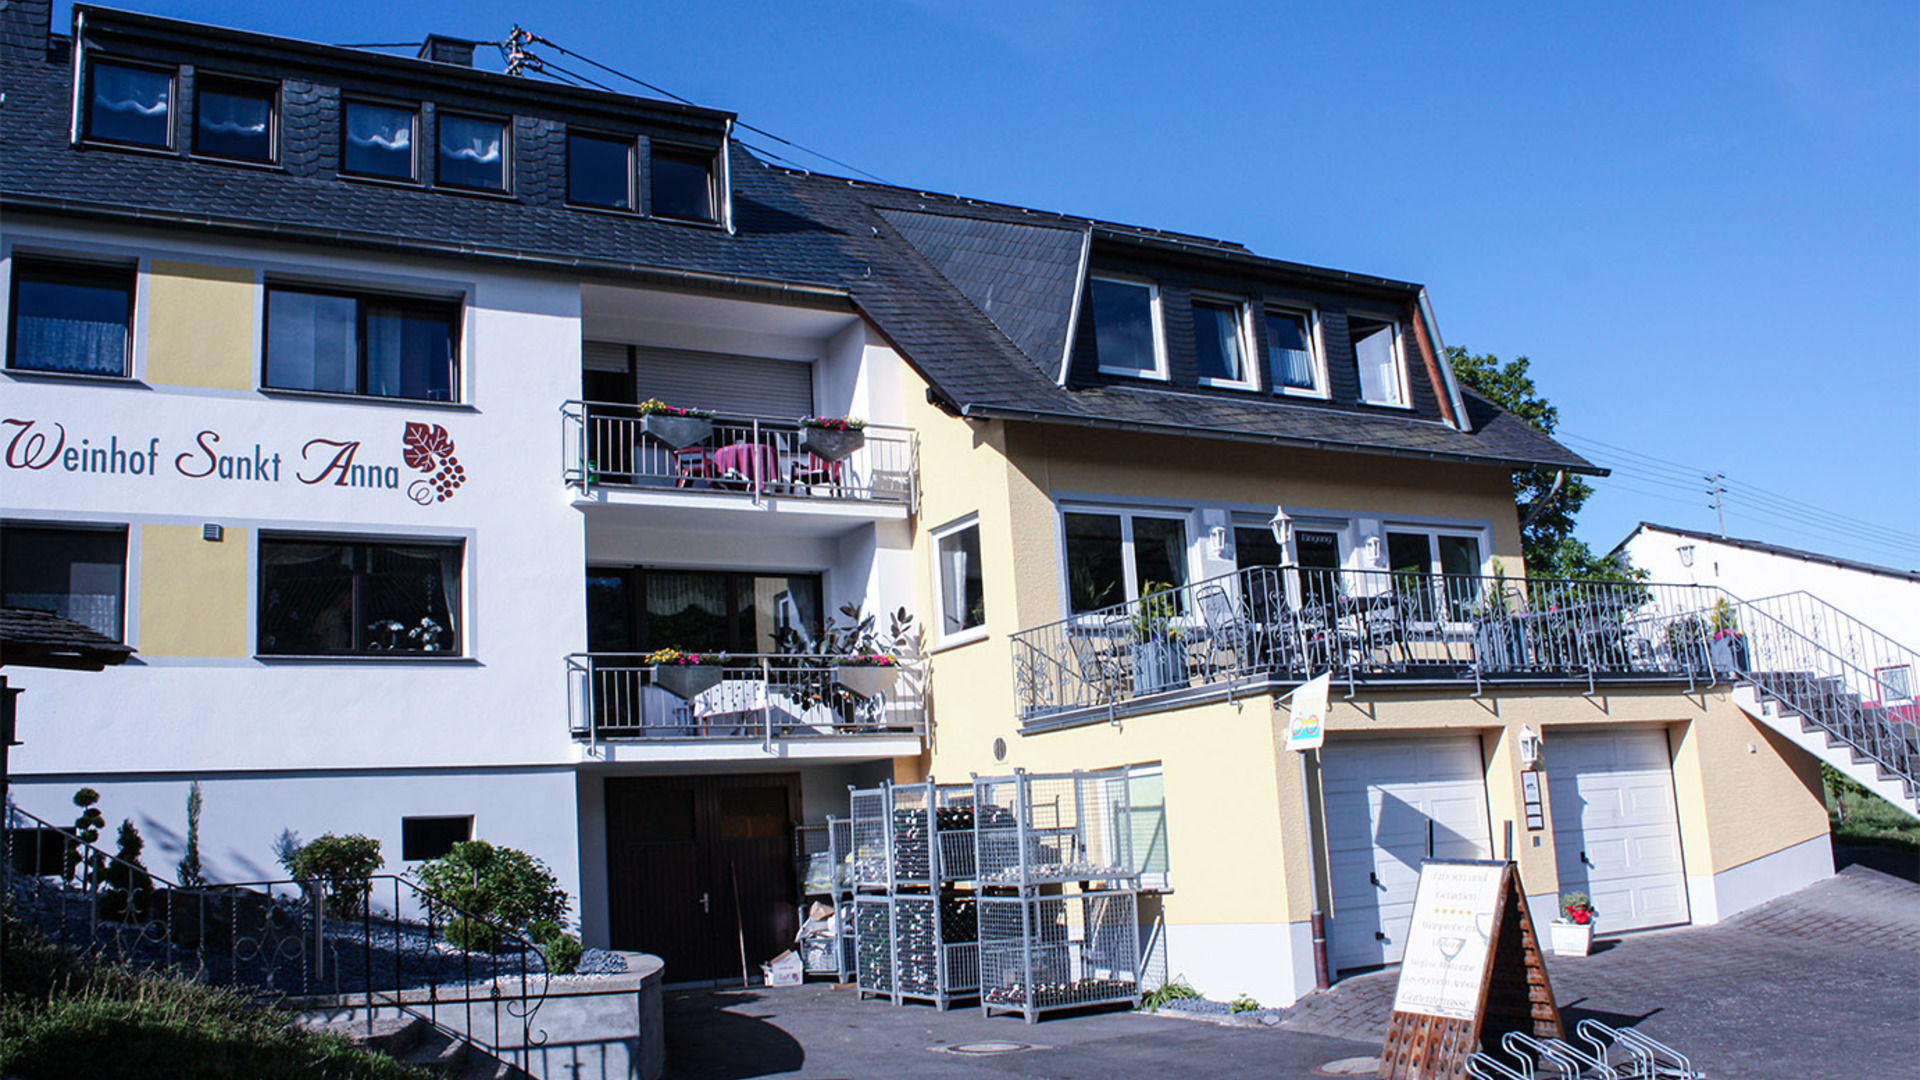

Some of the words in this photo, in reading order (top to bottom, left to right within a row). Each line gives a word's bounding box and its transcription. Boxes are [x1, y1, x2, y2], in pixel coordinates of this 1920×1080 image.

[1, 418, 160, 476] Weinhof
[175, 430, 281, 483] Sankt
[296, 439, 400, 489] Anna
